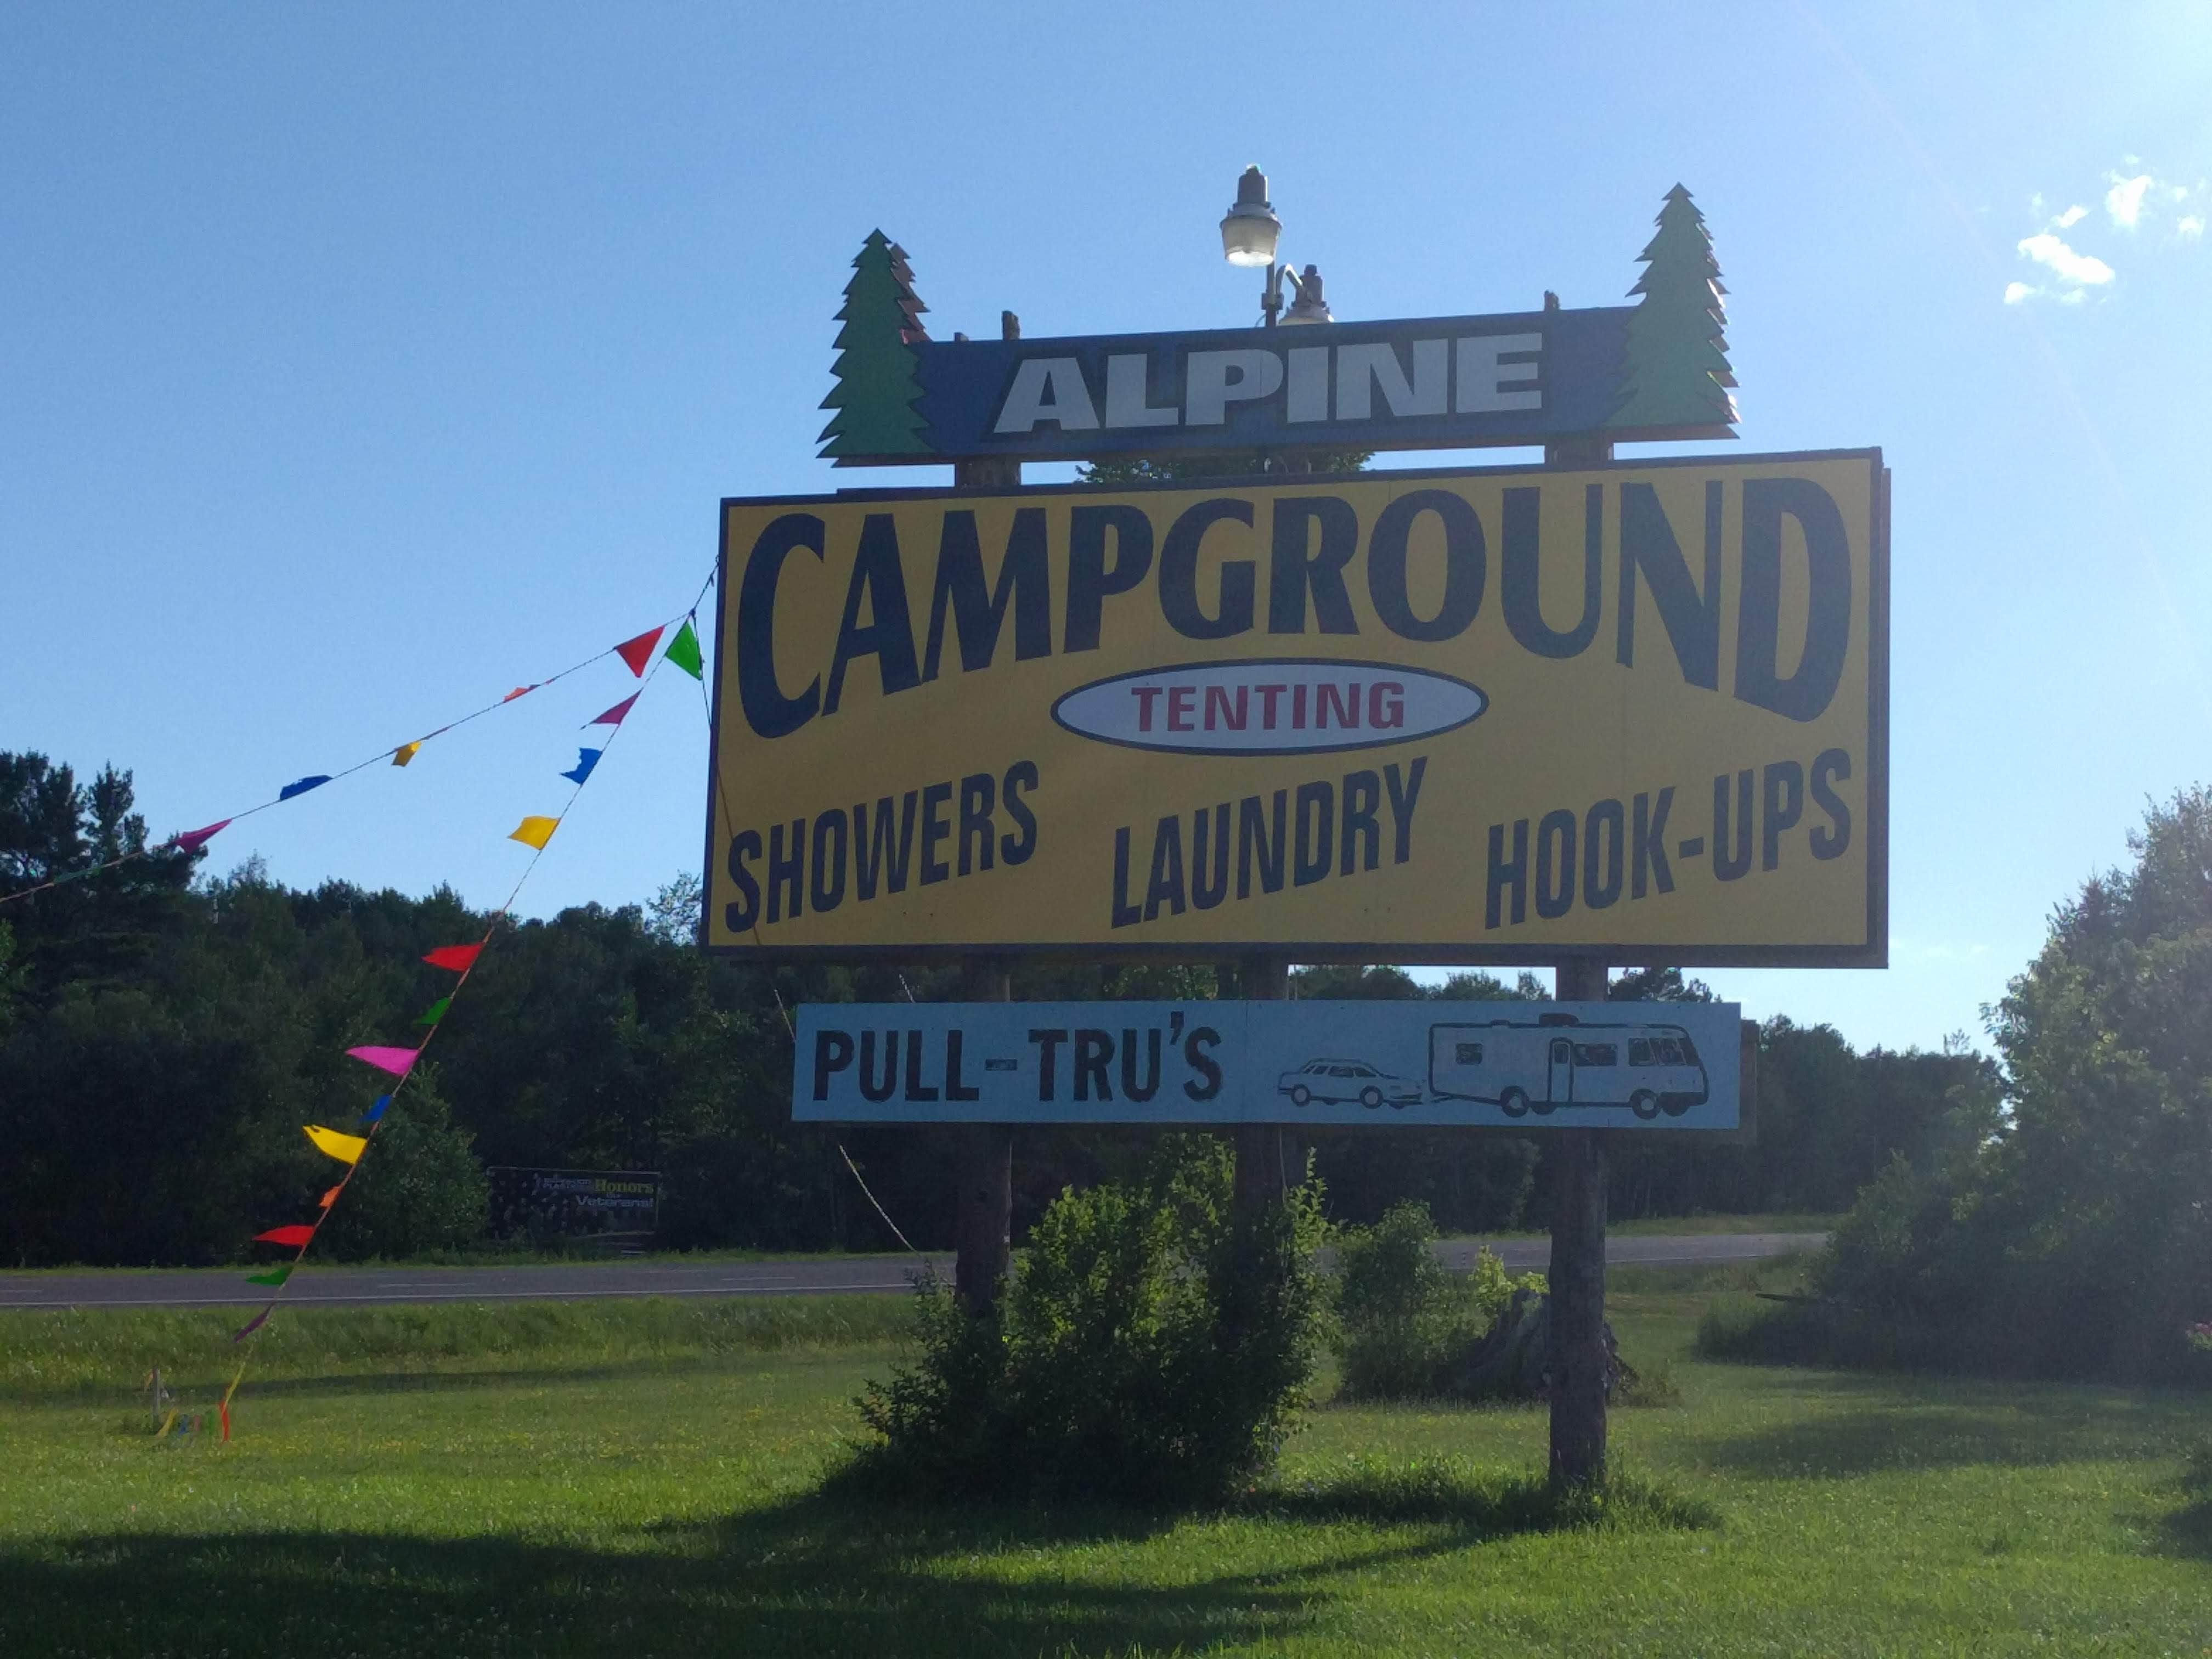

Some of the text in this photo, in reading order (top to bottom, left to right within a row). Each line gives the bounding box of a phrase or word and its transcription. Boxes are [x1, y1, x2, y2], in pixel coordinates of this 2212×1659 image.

[994, 332, 1543, 433] ALPINE
[737, 477, 1852, 739] CAMPGROUND
[1131, 682, 1404, 731] TENTING
[726, 761, 1039, 933] SHOWERS
[1113, 758, 1427, 928] LAUNDRY
[1486, 749, 1852, 929] HOOK-UPS
[813, 1011, 1222, 1102] PULL-TRU'S
